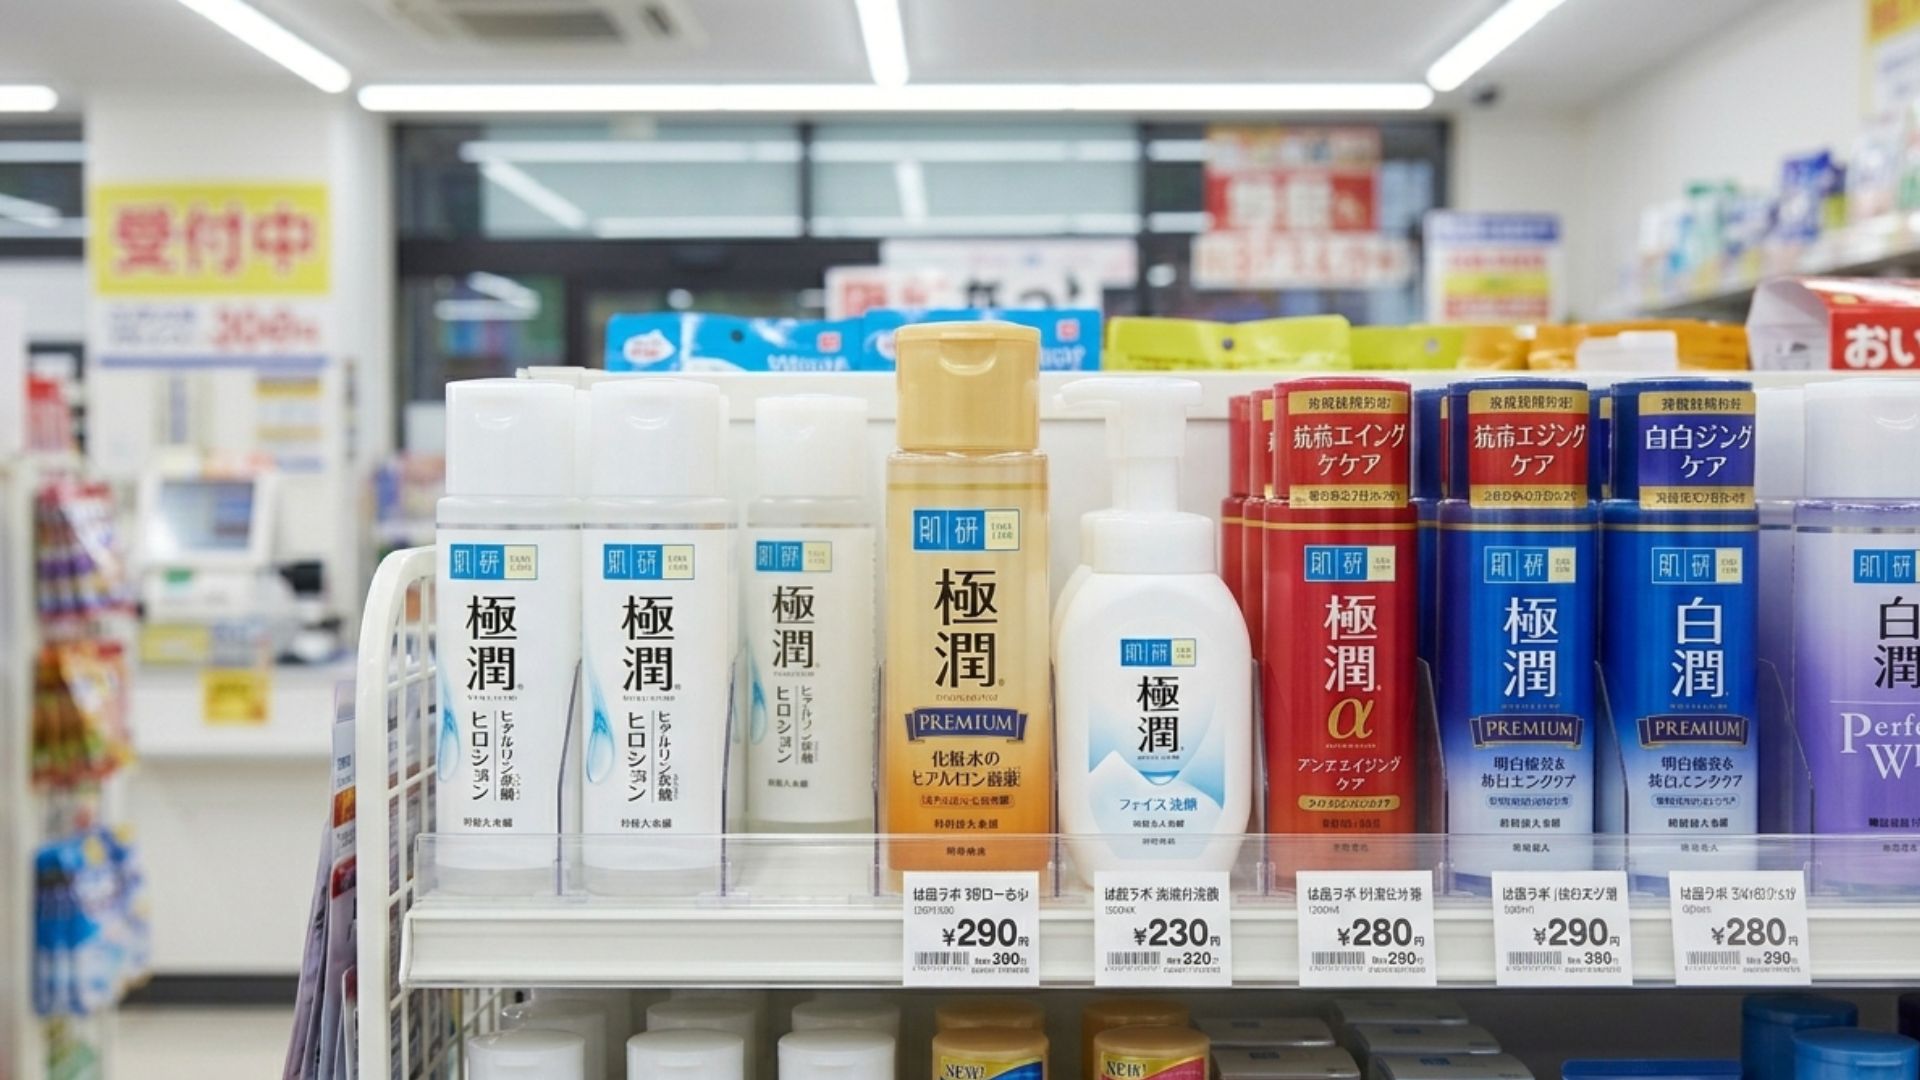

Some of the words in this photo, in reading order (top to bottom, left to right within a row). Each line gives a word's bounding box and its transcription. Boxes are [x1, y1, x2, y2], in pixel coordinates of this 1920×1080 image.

[1510, 454, 1554, 476] ケア
[1680, 455, 1727, 478] ケア
[465, 595, 518, 691] 極潤
[621, 595, 675, 691] 極潤
[772, 585, 815, 668] 極潤
[934, 568, 998, 688] 極潤
[1323, 594, 1378, 692] 極潤
[1503, 597, 1559, 698] 極潤
[1671, 596, 1724, 698] 白潤
[1873, 595, 1920, 689] 白潤
[919, 714, 1013, 731] PREMIUM
[1136, 675, 1179, 753] 極潤
[1486, 721, 1573, 737] PREMIUM
[1655, 720, 1740, 737] PREMIUM
